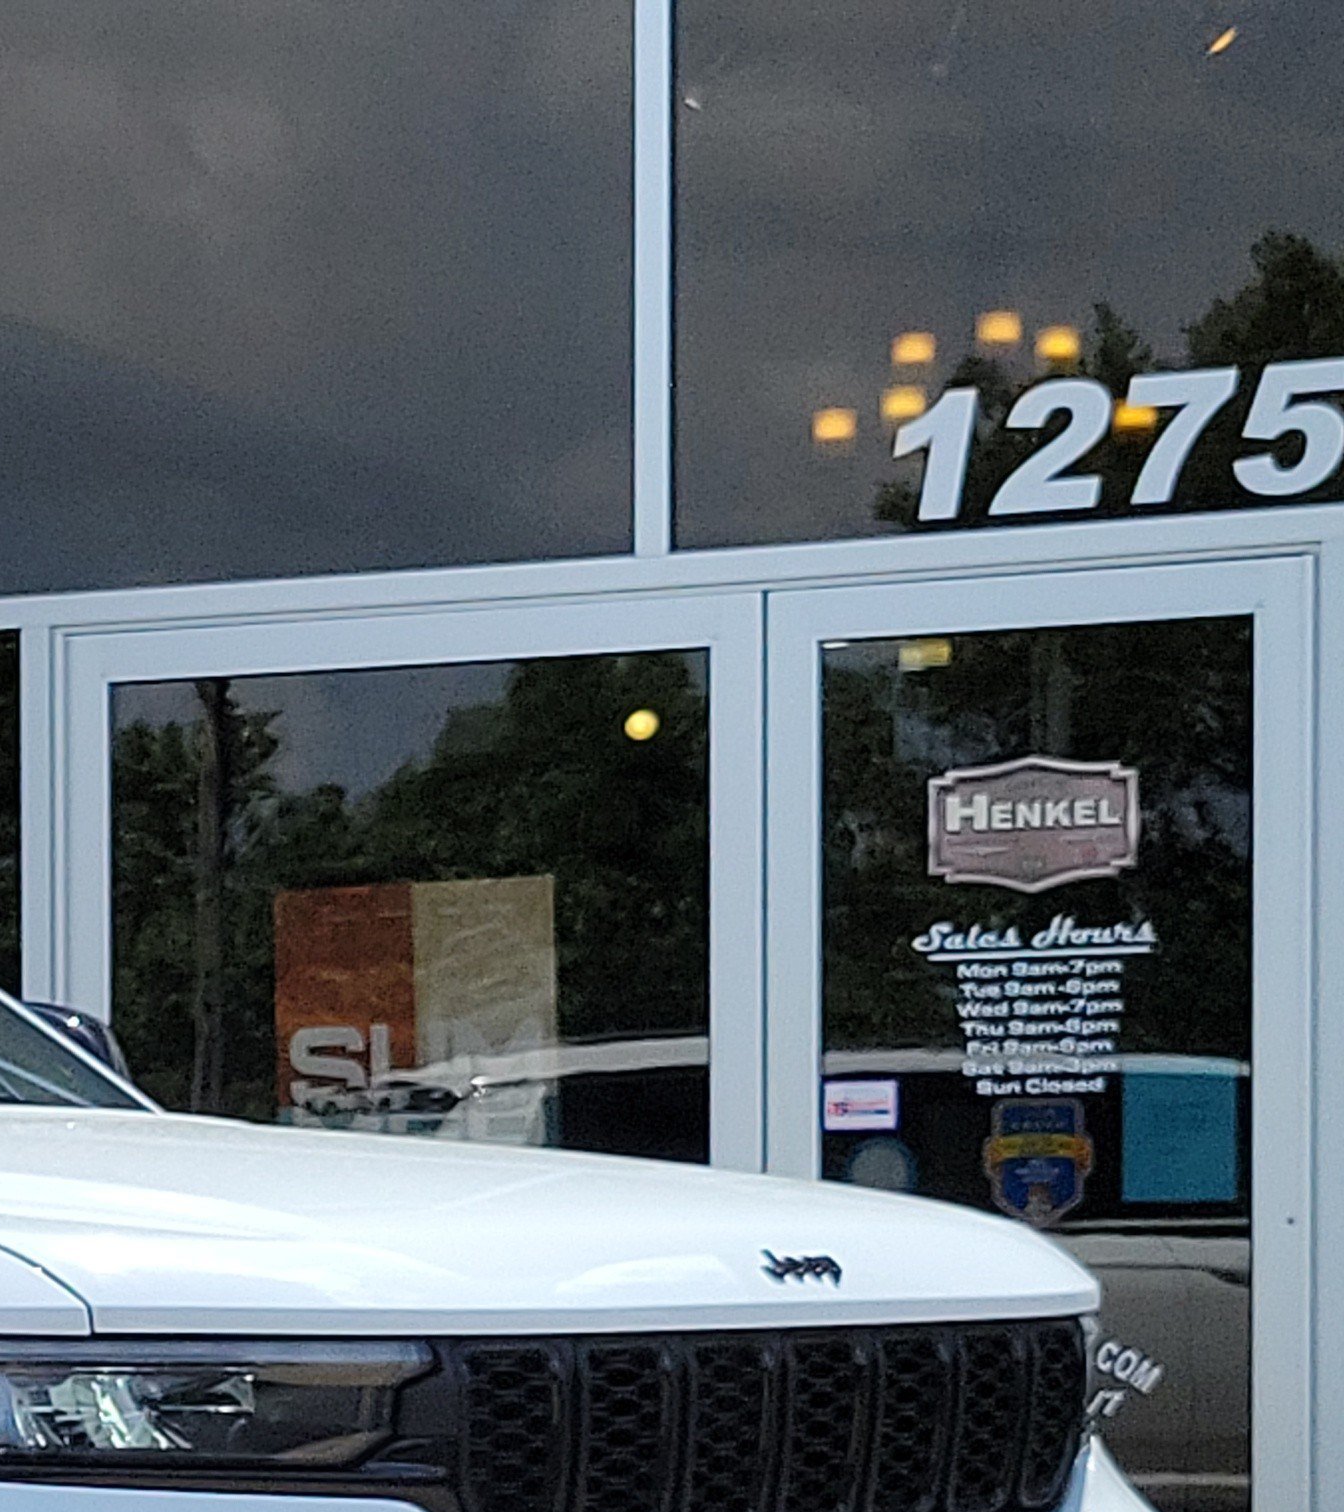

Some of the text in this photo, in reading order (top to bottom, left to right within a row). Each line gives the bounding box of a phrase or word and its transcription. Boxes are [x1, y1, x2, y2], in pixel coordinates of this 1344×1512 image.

[893, 360, 1344, 522] 1275
[945, 794, 1122, 833] HENKEL
[912, 913, 1157, 951] Sales Hours
[956, 963, 1008, 979] Mon
[959, 982, 1003, 999] Tue
[956, 1001, 1009, 1018] Wed
[960, 1020, 1005, 1037] Thu
[966, 1040, 1000, 1056] Fri
[962, 1060, 1006, 1077] Sat
[976, 1077, 1106, 1095] Sun Closed
